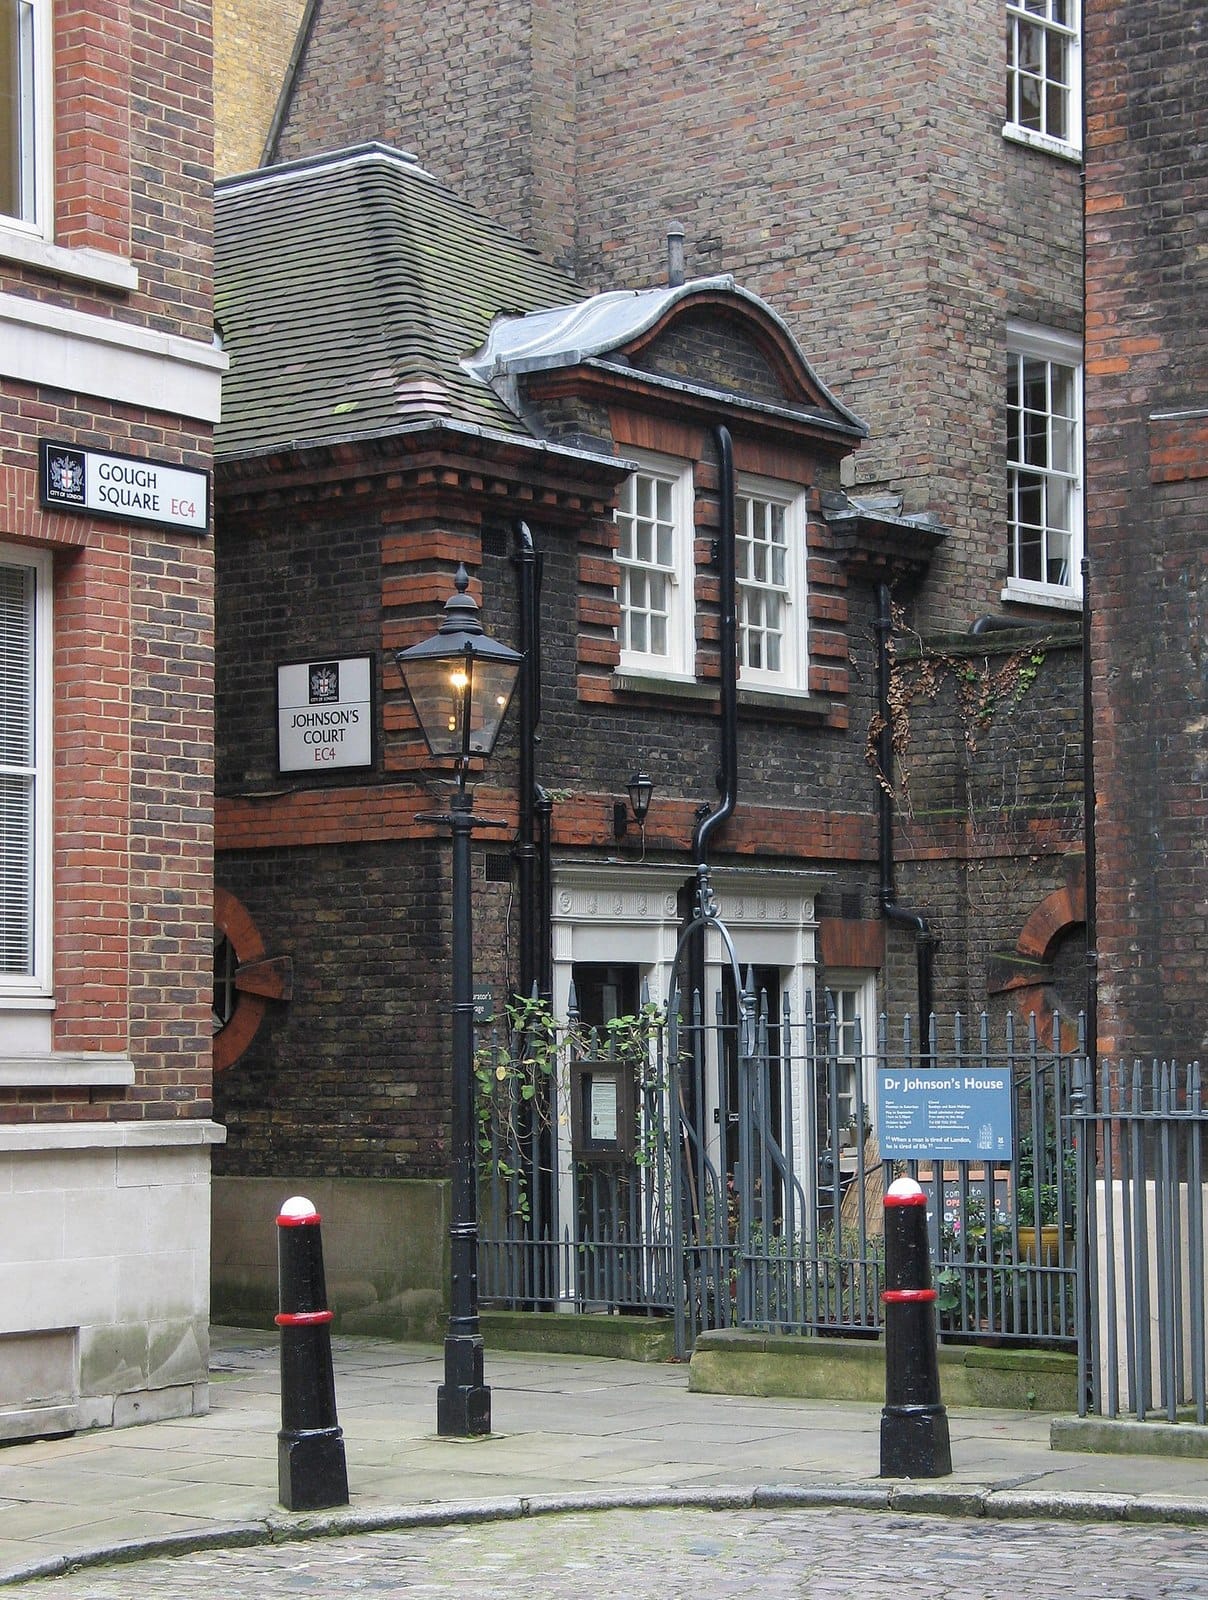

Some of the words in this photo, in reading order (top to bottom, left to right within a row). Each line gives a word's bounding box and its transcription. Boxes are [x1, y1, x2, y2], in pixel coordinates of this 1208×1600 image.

[98, 463, 156, 489] GOUGH
[98, 485, 160, 512] SQUARE
[171, 498, 196, 518] EC4
[291, 710, 359, 728] JOHNSON'S
[304, 728, 346, 744] COURT
[314, 748, 336, 761] EC4
[884, 1078, 900, 1090] Dr
[903, 1078, 960, 1092] Johnson's
[964, 1078, 1003, 1089] House
